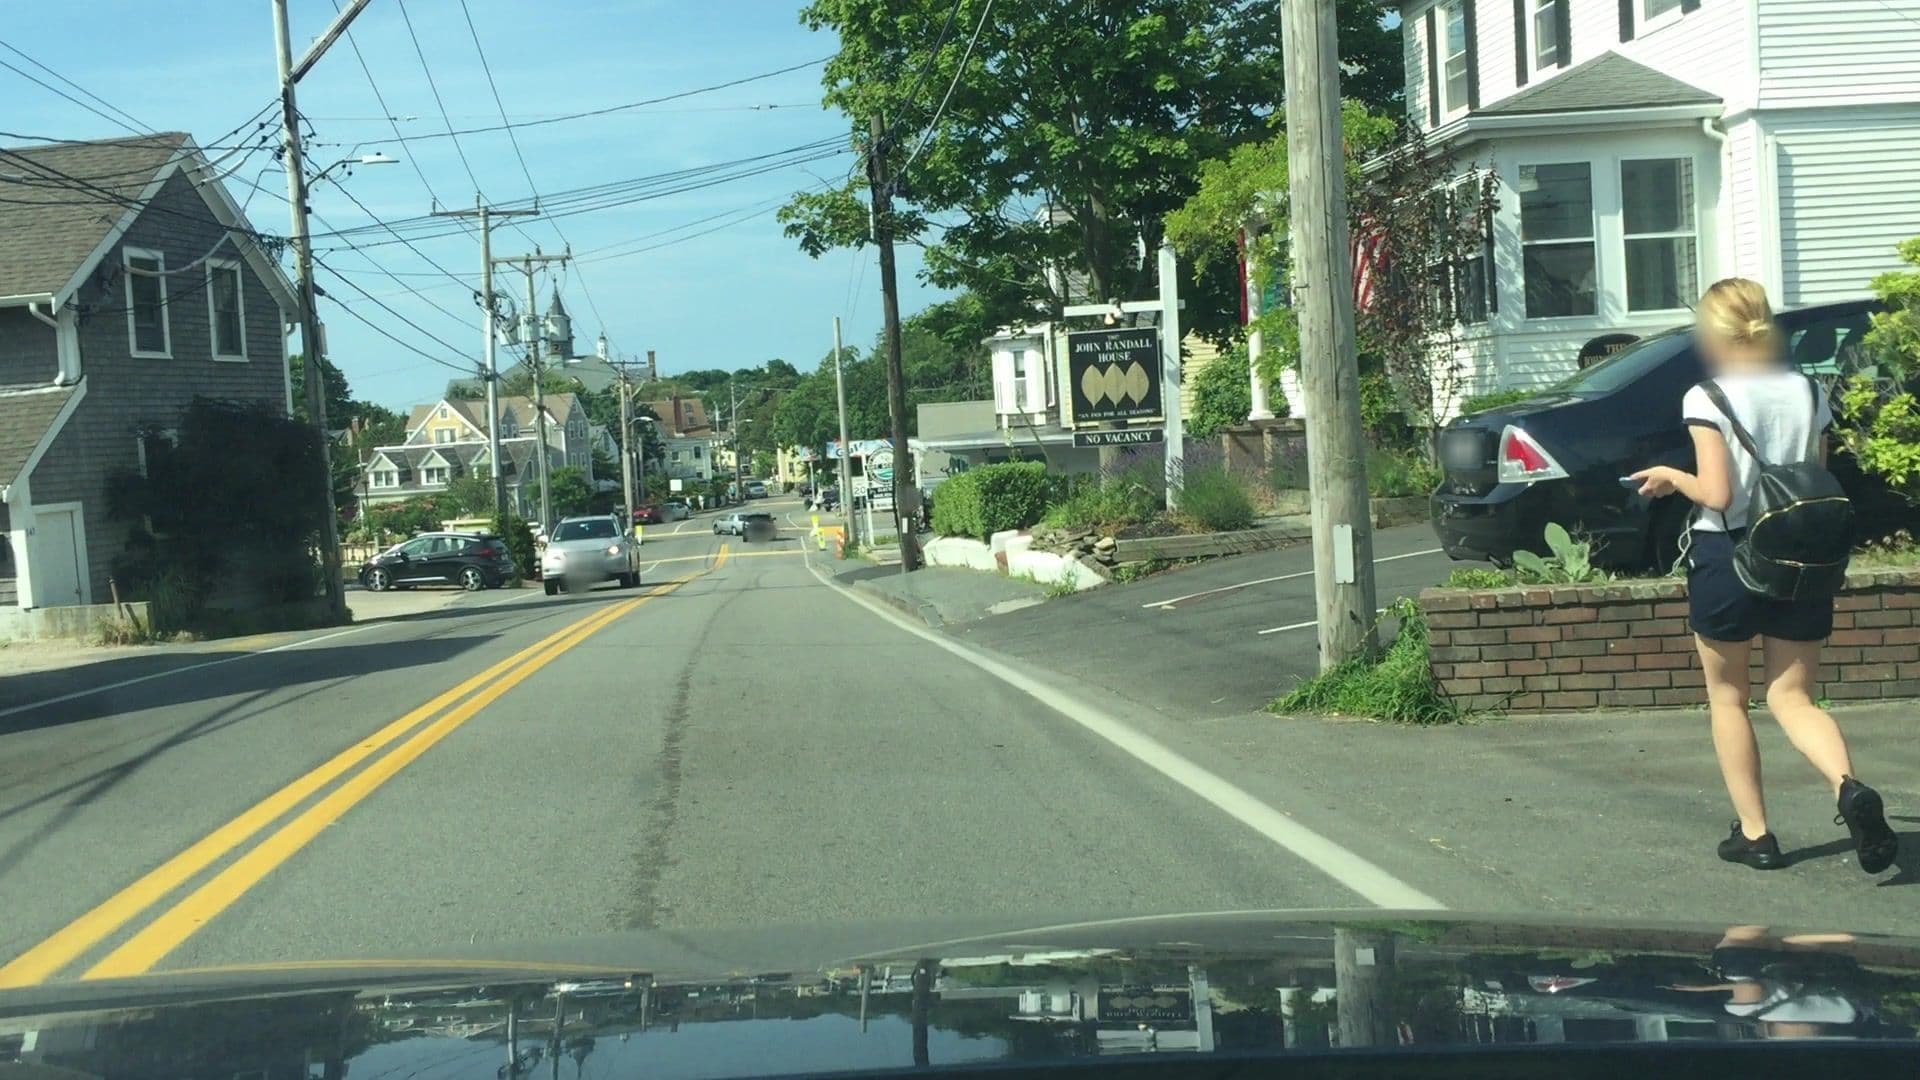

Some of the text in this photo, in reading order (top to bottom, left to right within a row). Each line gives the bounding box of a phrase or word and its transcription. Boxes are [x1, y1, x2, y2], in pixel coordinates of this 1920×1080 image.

[1076, 338, 1152, 353] JOHN RANDALL
[1098, 351, 1131, 362] HOUSE
[1086, 431, 1152, 444] NO VACANCY
[854, 486, 866, 495] 20
